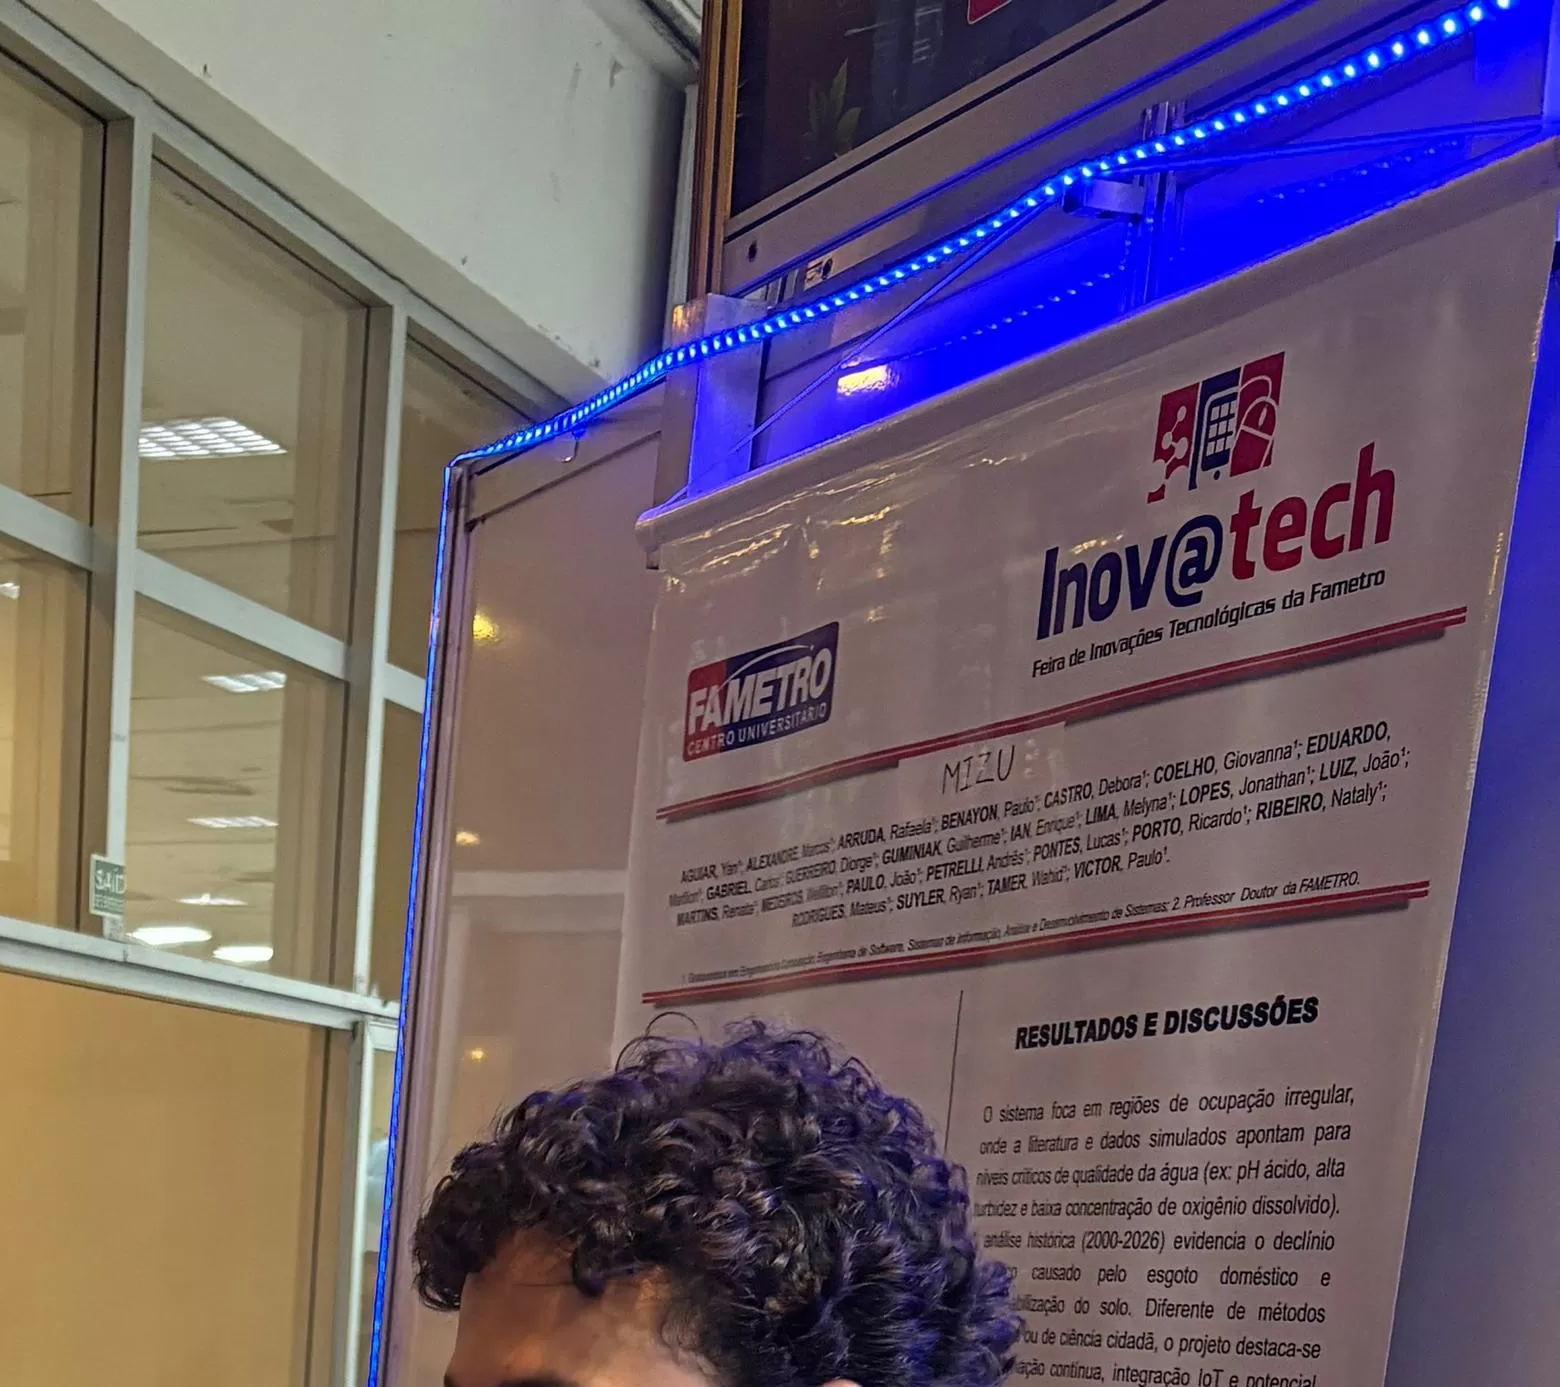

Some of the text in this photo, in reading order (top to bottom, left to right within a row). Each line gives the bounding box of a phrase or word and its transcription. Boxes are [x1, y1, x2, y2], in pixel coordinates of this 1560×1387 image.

[1036, 441, 1395, 640] Inov@tech
[1032, 569, 1385, 678] Feira de Inovações Tecnológicas da Fametro
[688, 648, 832, 736] FAMETRO
[688, 730, 735, 755] CENTRO
[942, 745, 1016, 795] MIZU
[1043, 721, 1390, 809] CASTRO, COELHO, EDUARDO,
[1085, 757, 1358, 825] LIMA, LOPES, LUIZ,
[1132, 792, 1326, 843] PORTO, RIBEIRO,
[95, 866, 125, 894] SAÍD
[1240, 884, 1277, 902] Doutor
[1299, 871, 1360, 894] FAMETRO.
[1015, 1014, 1137, 1050] RESULTADOS
[1144, 1012, 1158, 1036] E
[999, 1084, 1354, 1122] sistema foca em regiões de ocupação irregular,
[980, 1124, 1350, 1155] onde literatura dados simulados apontam para
[1054, 1158, 1345, 1188] de qualidade da água (ex: pH ácido, alta
[1065, 1193, 1339, 1220] concentração de oxigênio dissolvido).
[1028, 1229, 1334, 1253] histórica (2000-2026) evidencia o declínio
[1032, 1264, 1331, 1290] causado pelo esgoto doméstico e
[1074, 1296, 1326, 1323] do solo. Diferente de métodos
[1059, 1328, 1321, 1359] ciência cidadã, o projeto destaca-se
[1050, 1362, 1104, 1382] contínua,
